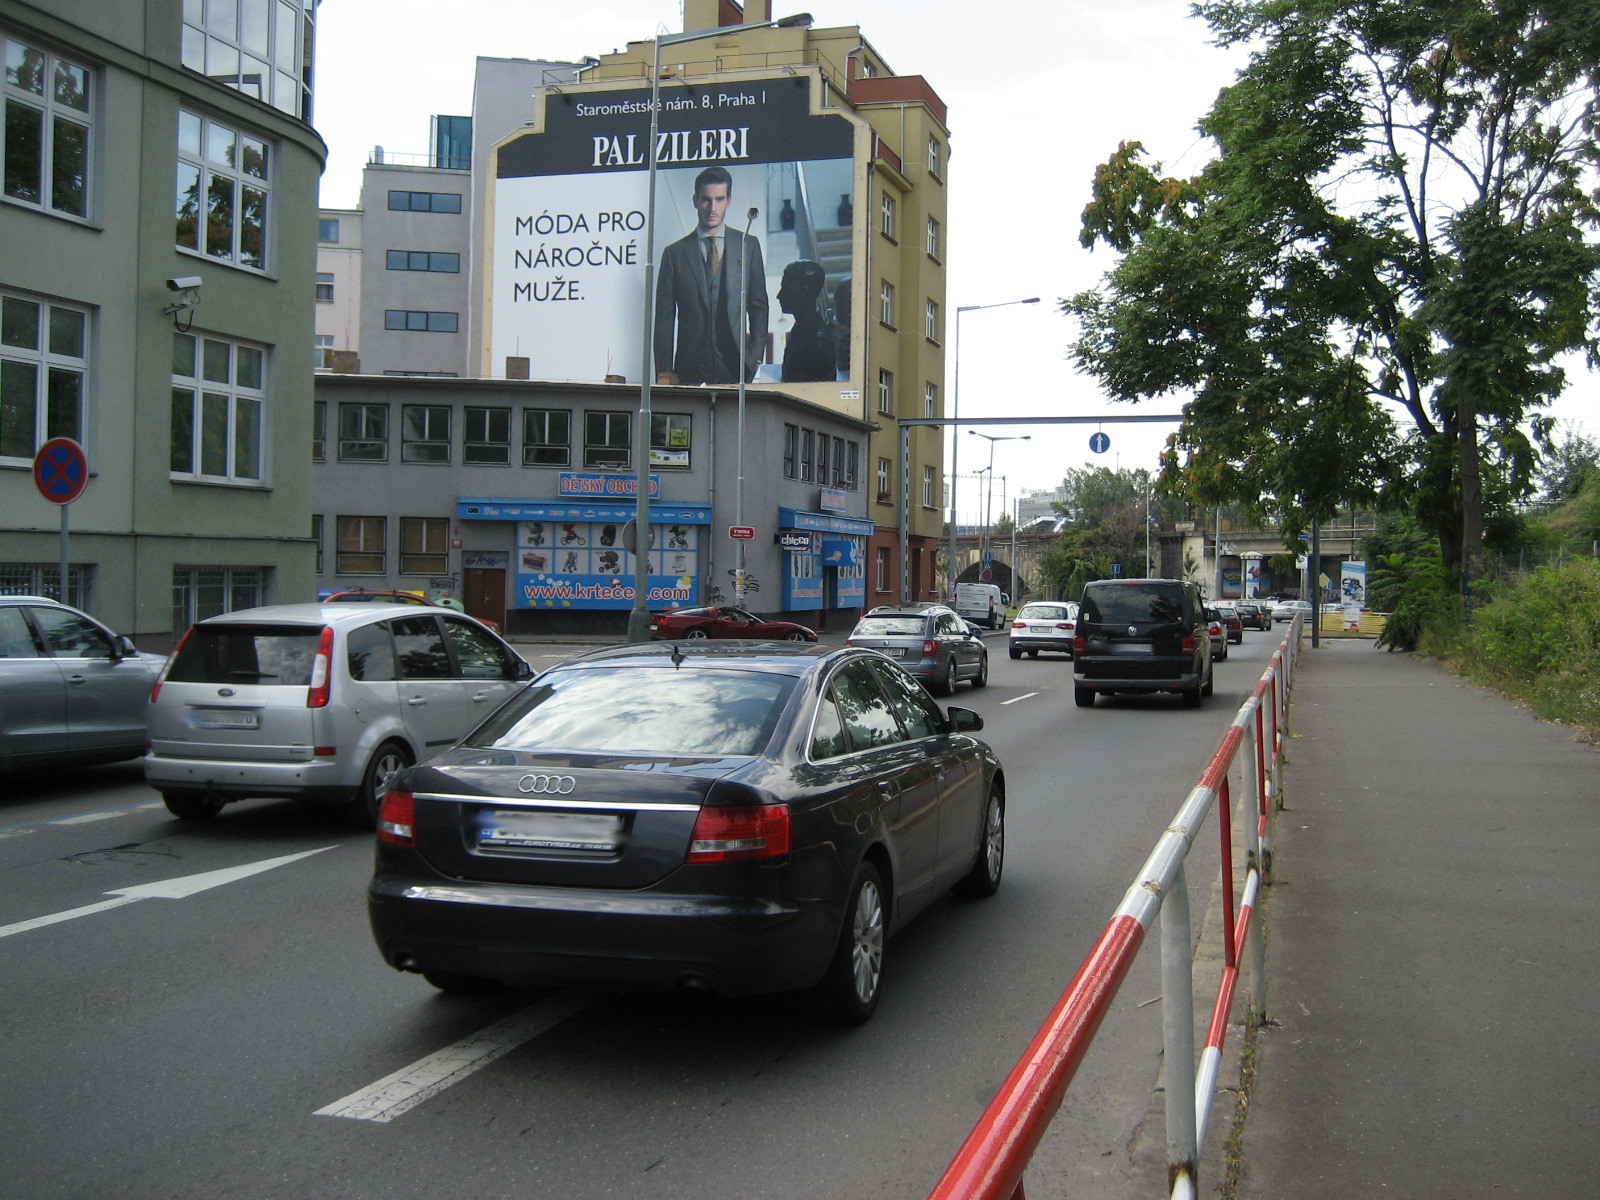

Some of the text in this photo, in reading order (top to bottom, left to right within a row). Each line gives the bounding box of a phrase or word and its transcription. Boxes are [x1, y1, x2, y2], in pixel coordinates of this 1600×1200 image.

[576, 99, 662, 117] Staroměstské
[666, 96, 698, 111] nám.
[702, 94, 714, 110] 8,
[718, 92, 756, 107] Praha
[592, 127, 750, 167] PAL ZILERI
[515, 209, 646, 236] MÓDA PRO
[515, 239, 637, 269] NÁROČNÉ
[514, 275, 585, 302] MUŽE.
[561, 474, 658, 494] DĚTSKÝ OBCHD
[524, 583, 690, 600] www.krteče.com
